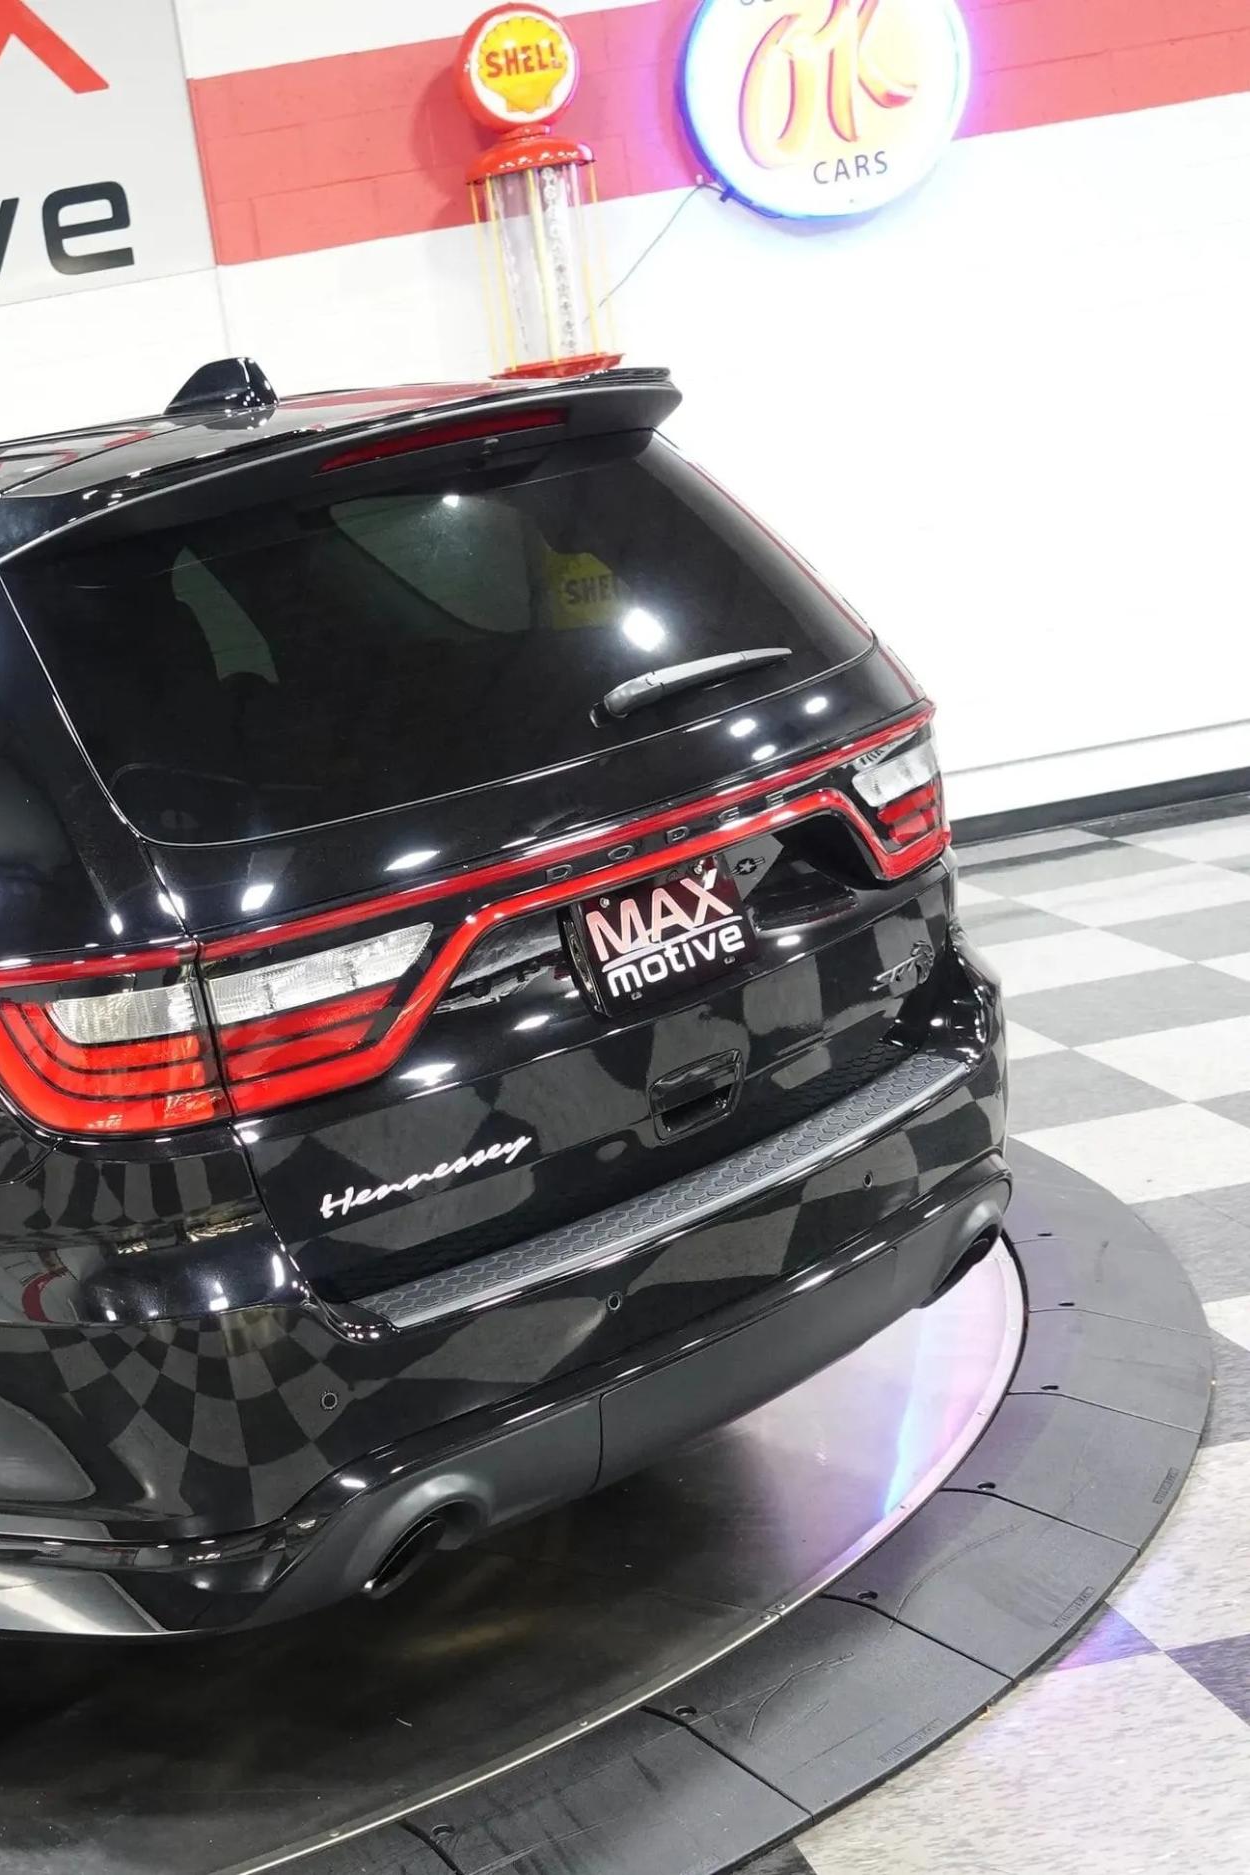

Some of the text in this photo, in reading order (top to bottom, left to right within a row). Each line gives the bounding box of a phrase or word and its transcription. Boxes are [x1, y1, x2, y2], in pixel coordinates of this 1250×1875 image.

[485, 42, 563, 78] SHELL
[813, 150, 889, 184] CARS
[546, 792, 784, 881] DODGE
[586, 878, 734, 962] MAX
[607, 924, 746, 997] motive
[320, 1136, 532, 1219] Hennessey
